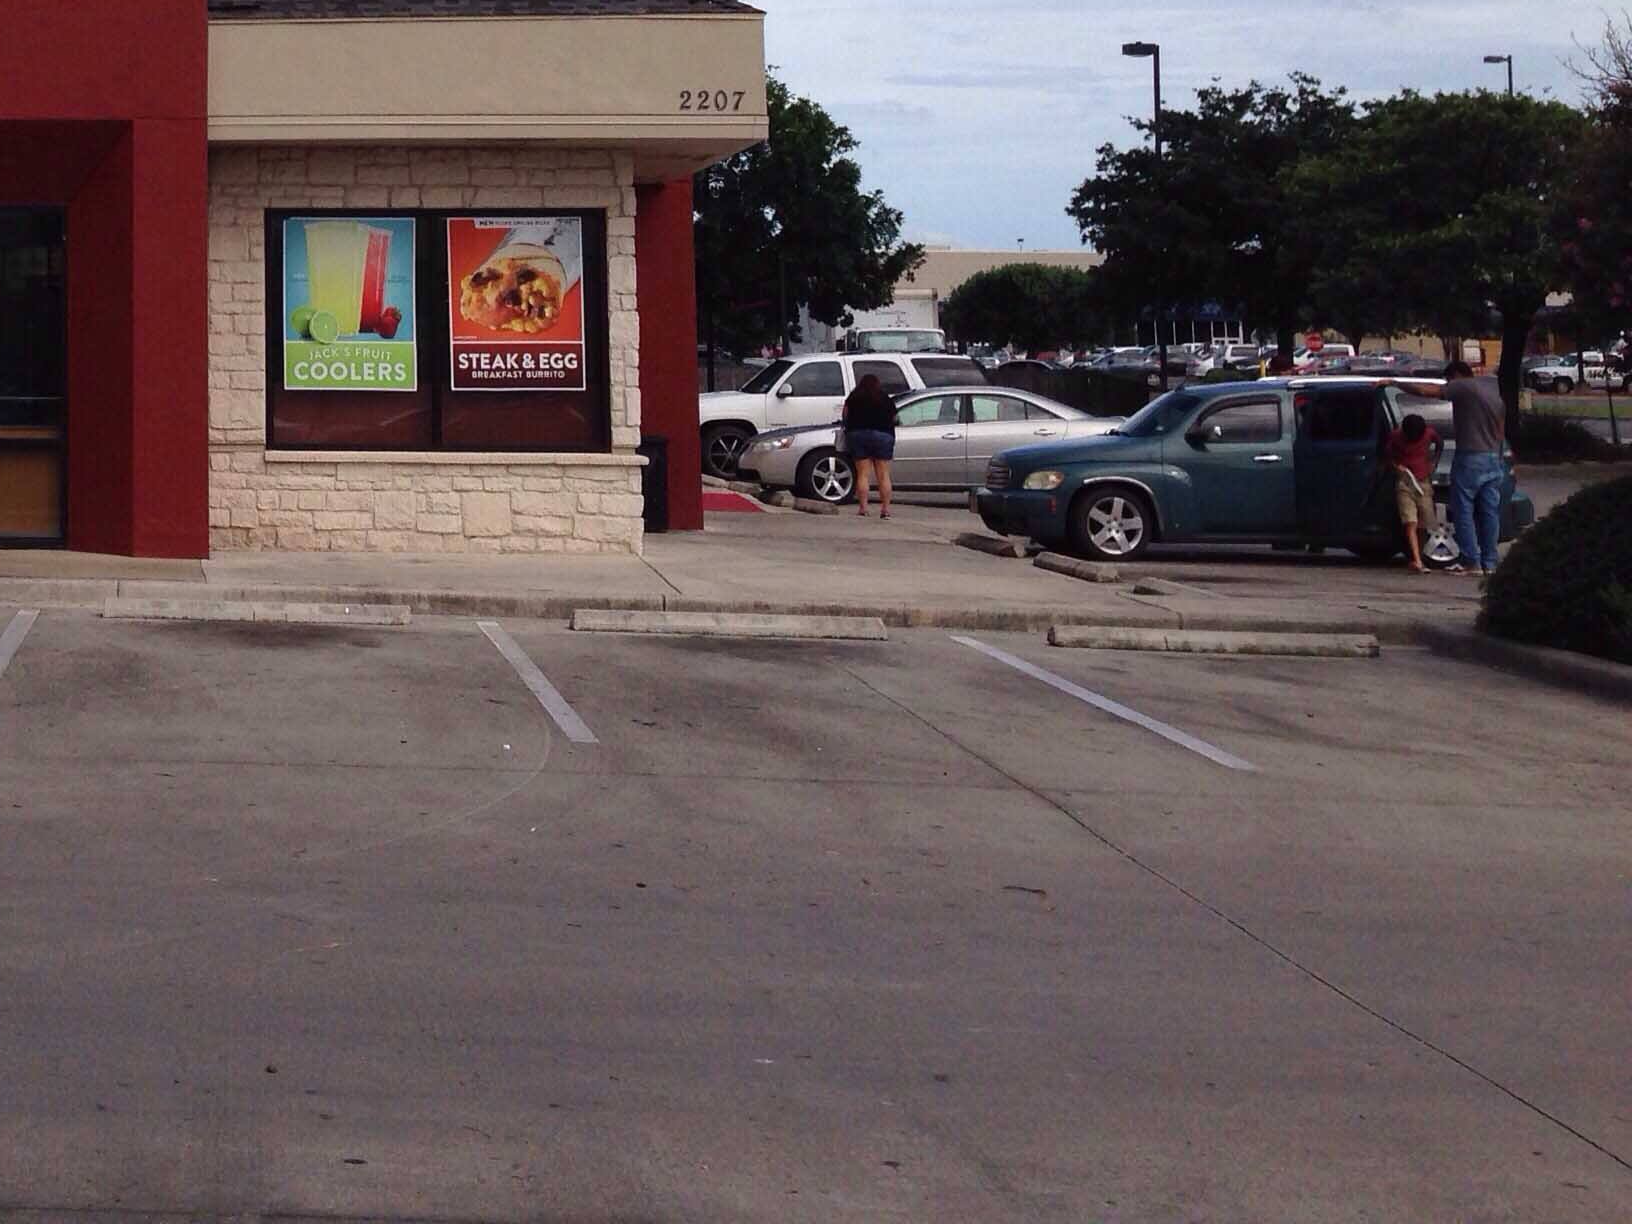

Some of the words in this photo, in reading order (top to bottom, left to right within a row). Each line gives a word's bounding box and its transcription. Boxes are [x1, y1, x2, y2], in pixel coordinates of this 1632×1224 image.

[679, 90, 745, 111] 2207
[355, 346, 393, 361] FRUIT
[458, 353, 520, 369] STEAK
[522, 353, 536, 369] &
[539, 353, 578, 369] EGG
[294, 361, 407, 381] COOLERS
[471, 370, 523, 379] BREAKFAST
[526, 370, 566, 379] BURRITO
